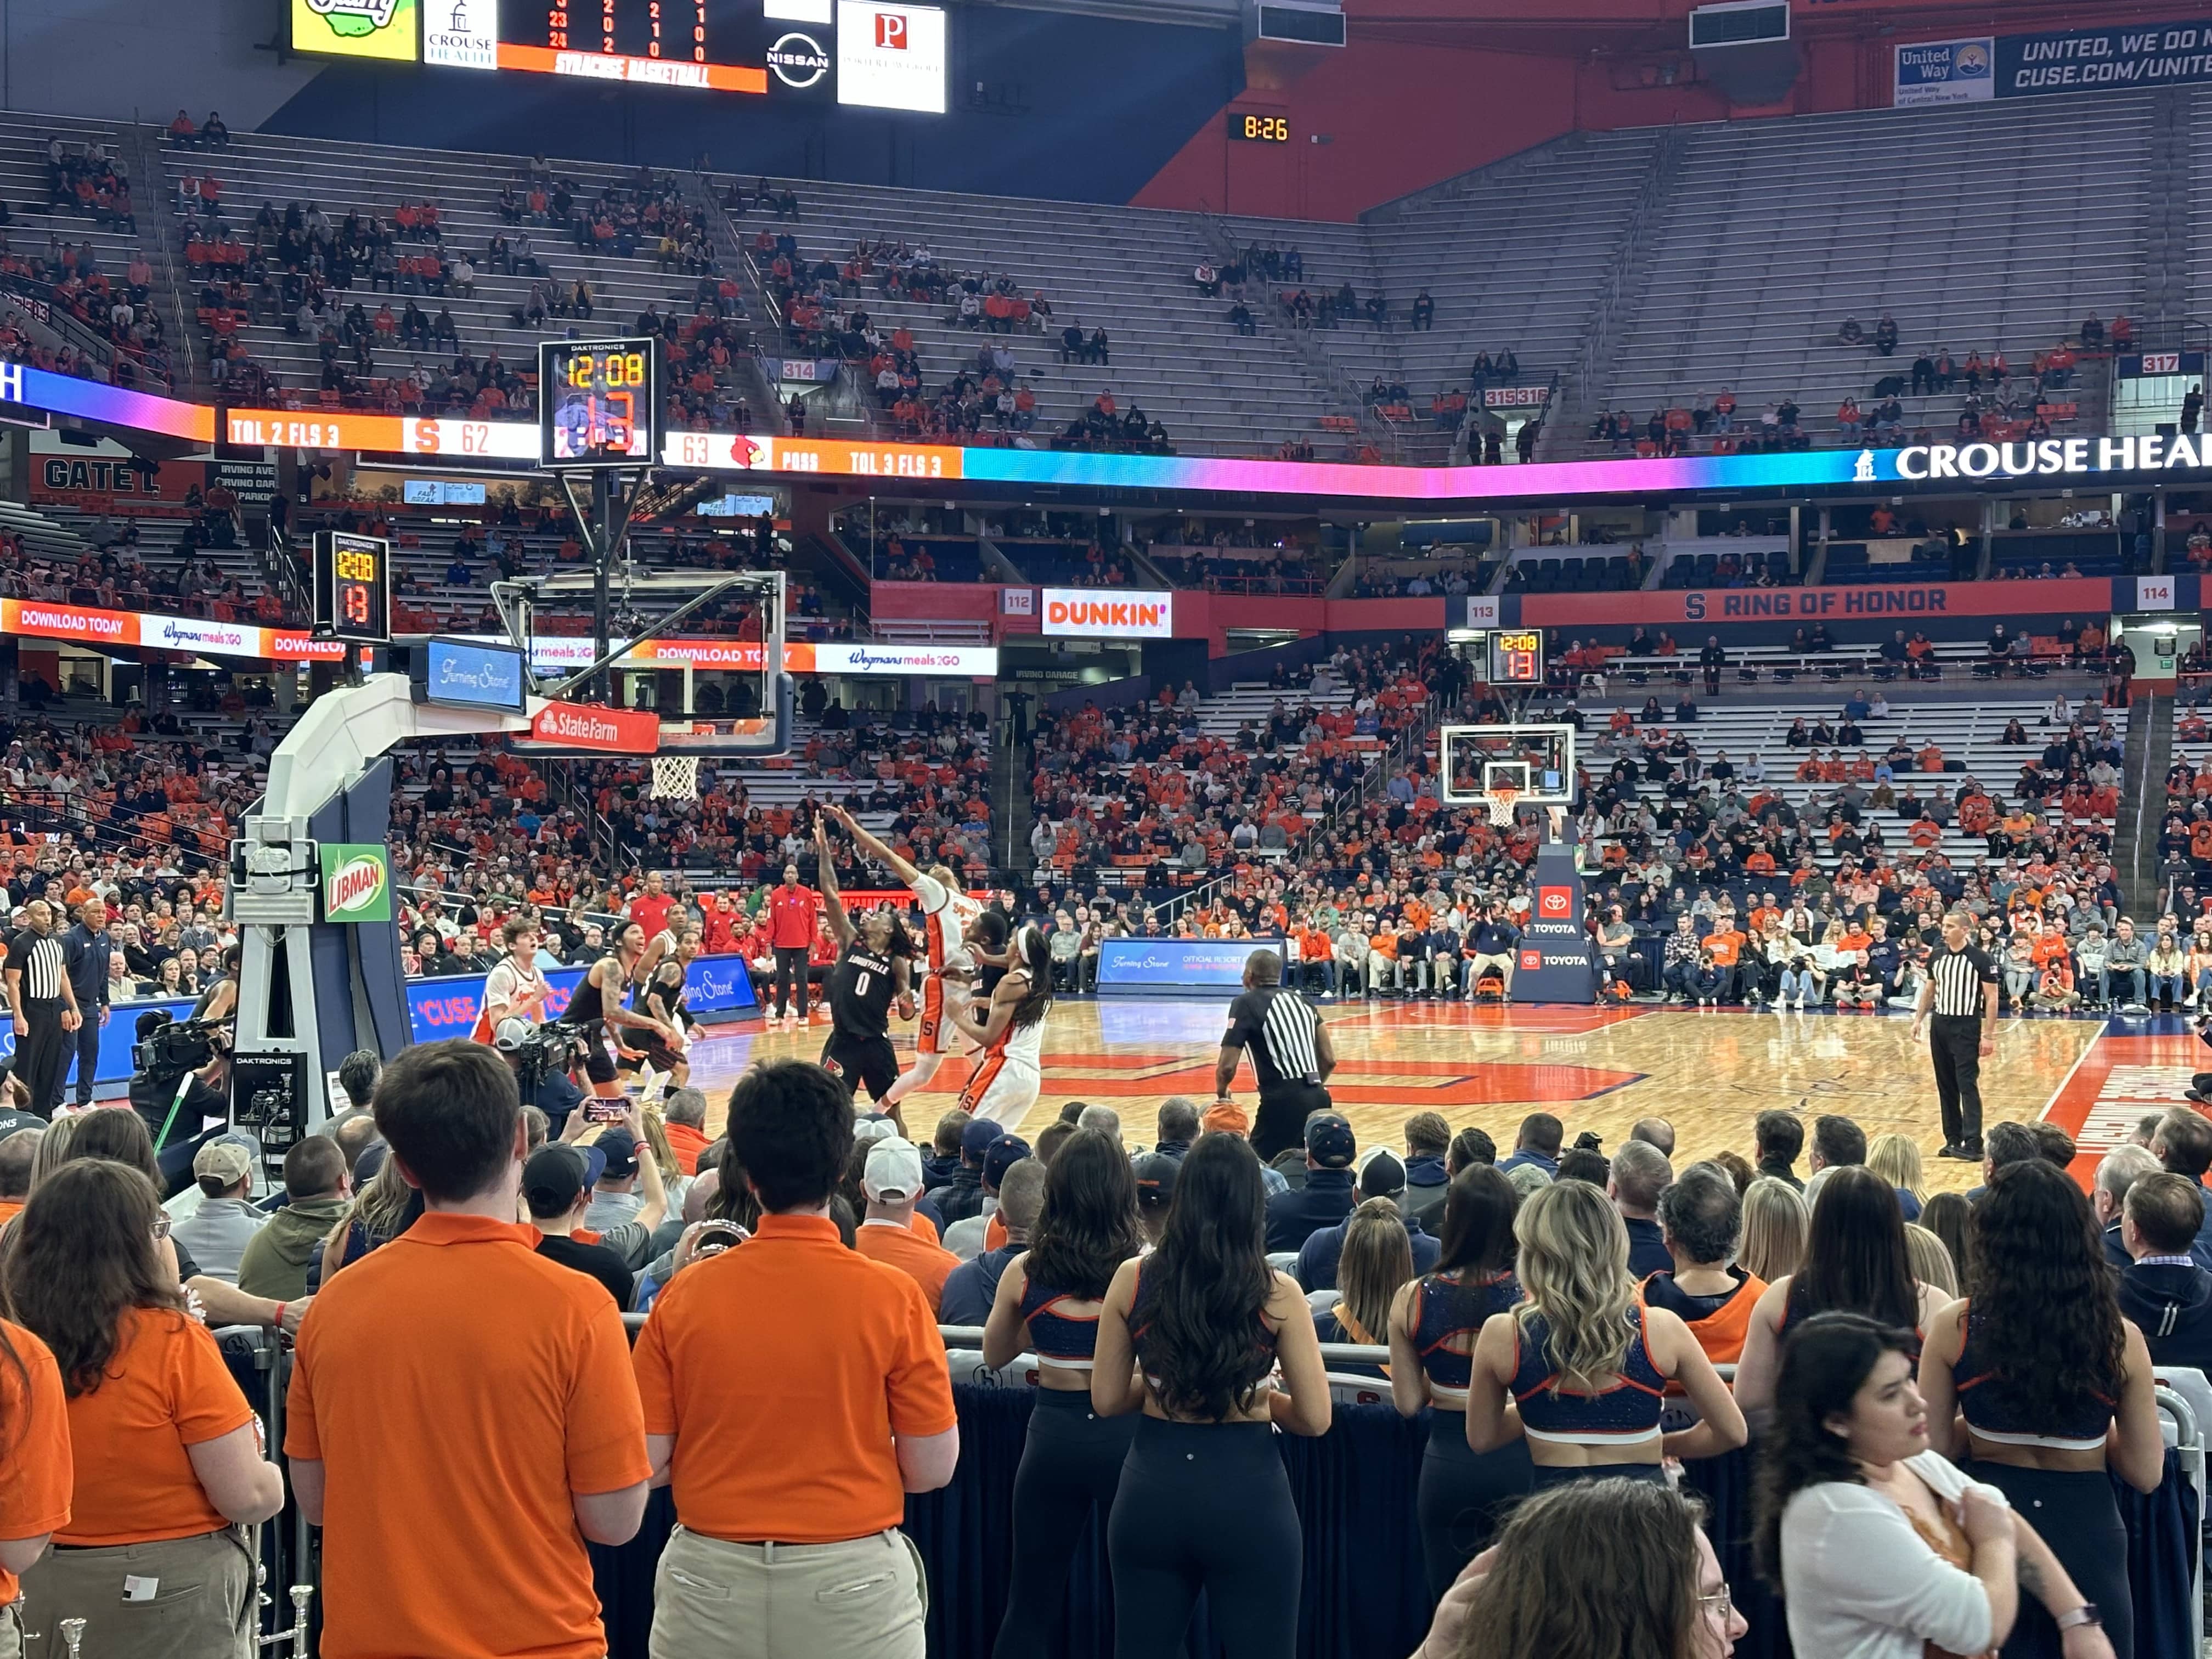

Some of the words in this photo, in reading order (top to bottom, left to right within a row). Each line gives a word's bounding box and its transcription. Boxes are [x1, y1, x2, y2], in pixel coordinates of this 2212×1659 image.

[649, 2, 659, 18] 2
[697, 7, 705, 23] 1
[550, 11, 567, 27] 23
[603, 16, 614, 32] 0
[651, 21, 659, 37] 1
[694, 26, 704, 41] 0
[881, 15, 904, 47] P
[429, 33, 492, 50] CROUSE
[550, 31, 567, 48] 24
[603, 37, 614, 53] 2
[649, 41, 659, 58] 0
[695, 46, 704, 61] 0
[2023, 37, 2114, 61] UNITED,
[2121, 32, 2159, 53] WE
[2164, 30, 2197, 50] DO
[766, 52, 828, 68] NISSAN
[1901, 48, 1950, 65] United
[555, 52, 626, 80] SYRACUSE
[627, 59, 710, 88] BASKETBALL
[1920, 64, 1950, 80] Way
[1898, 86, 1923, 95] United
[1924, 86, 1940, 94] Way
[1898, 97, 1905, 105] of
[1907, 95, 1934, 104] Central
[1244, 115, 1288, 141] 8:26
[571, 343, 625, 352] DAKTRONICS
[568, 353, 644, 388] 12:08
[784, 363, 814, 379] 314
[2145, 356, 2178, 372] 317
[1486, 390, 1515, 405] 315
[1517, 388, 1548, 403] 316
[587, 391, 634, 450] 13
[232, 419, 264, 444] TOL
[272, 422, 282, 445] 2
[289, 423, 321, 447] FLS
[328, 425, 340, 448] 3
[415, 421, 440, 454] S
[462, 424, 489, 454] 62
[683, 436, 709, 464] 63
[1895, 438, 2088, 480] CROUSE
[221, 465, 253, 474] IRVING
[782, 451, 819, 471] POSS
[850, 452, 878, 475] TOL
[883, 453, 893, 475] 3
[898, 455, 926, 476] FLS
[932, 456, 941, 476] 3
[44, 458, 134, 492] GATE
[221, 478, 253, 487] IRVING
[337, 538, 375, 549] DAKTRONICS
[337, 550, 374, 582] 12:08
[346, 585, 368, 623] 13
[1008, 596, 1030, 608] 112
[2143, 588, 2169, 600] 114
[1049, 601, 1166, 627] DUNKIN'
[1472, 606, 1493, 618] 113
[1684, 592, 1707, 622] S
[1724, 592, 1791, 616] RING
[1799, 591, 1836, 614] OF
[1846, 588, 1947, 613] HONOR
[21, 610, 87, 631] DOWNLOAD
[88, 617, 123, 635] TODAY
[163, 621, 202, 646] Wegmans
[202, 631, 225, 645] meals
[225, 633, 241, 645] 2GO
[1499, 635, 1537, 651] 12:08
[540, 645, 575, 658] meals
[577, 647, 597, 658] 2G
[657, 647, 742, 662] DOWNLOAD
[745, 651, 792, 664] TOY
[848, 648, 902, 670] Wegmans
[904, 653, 935, 665] meals
[937, 655, 960, 666] 2GO
[1016, 669, 1043, 678] IRVING
[1045, 670, 1079, 679] GARAGE
[1509, 651, 1534, 679] 13
[329, 863, 379, 912] LIBMAN
[1534, 924, 1576, 934] TOYOTA
[847, 953, 890, 976] LOUISVILLE
[1110, 956, 1142, 969] Turning
[1142, 956, 1169, 969] Stone
[1543, 956, 1588, 966] TOYOTA
[702, 970, 735, 1000] Stone
[855, 971, 870, 996] 0
[923, 1021, 934, 1036] S
[963, 1094, 974, 1110] S
